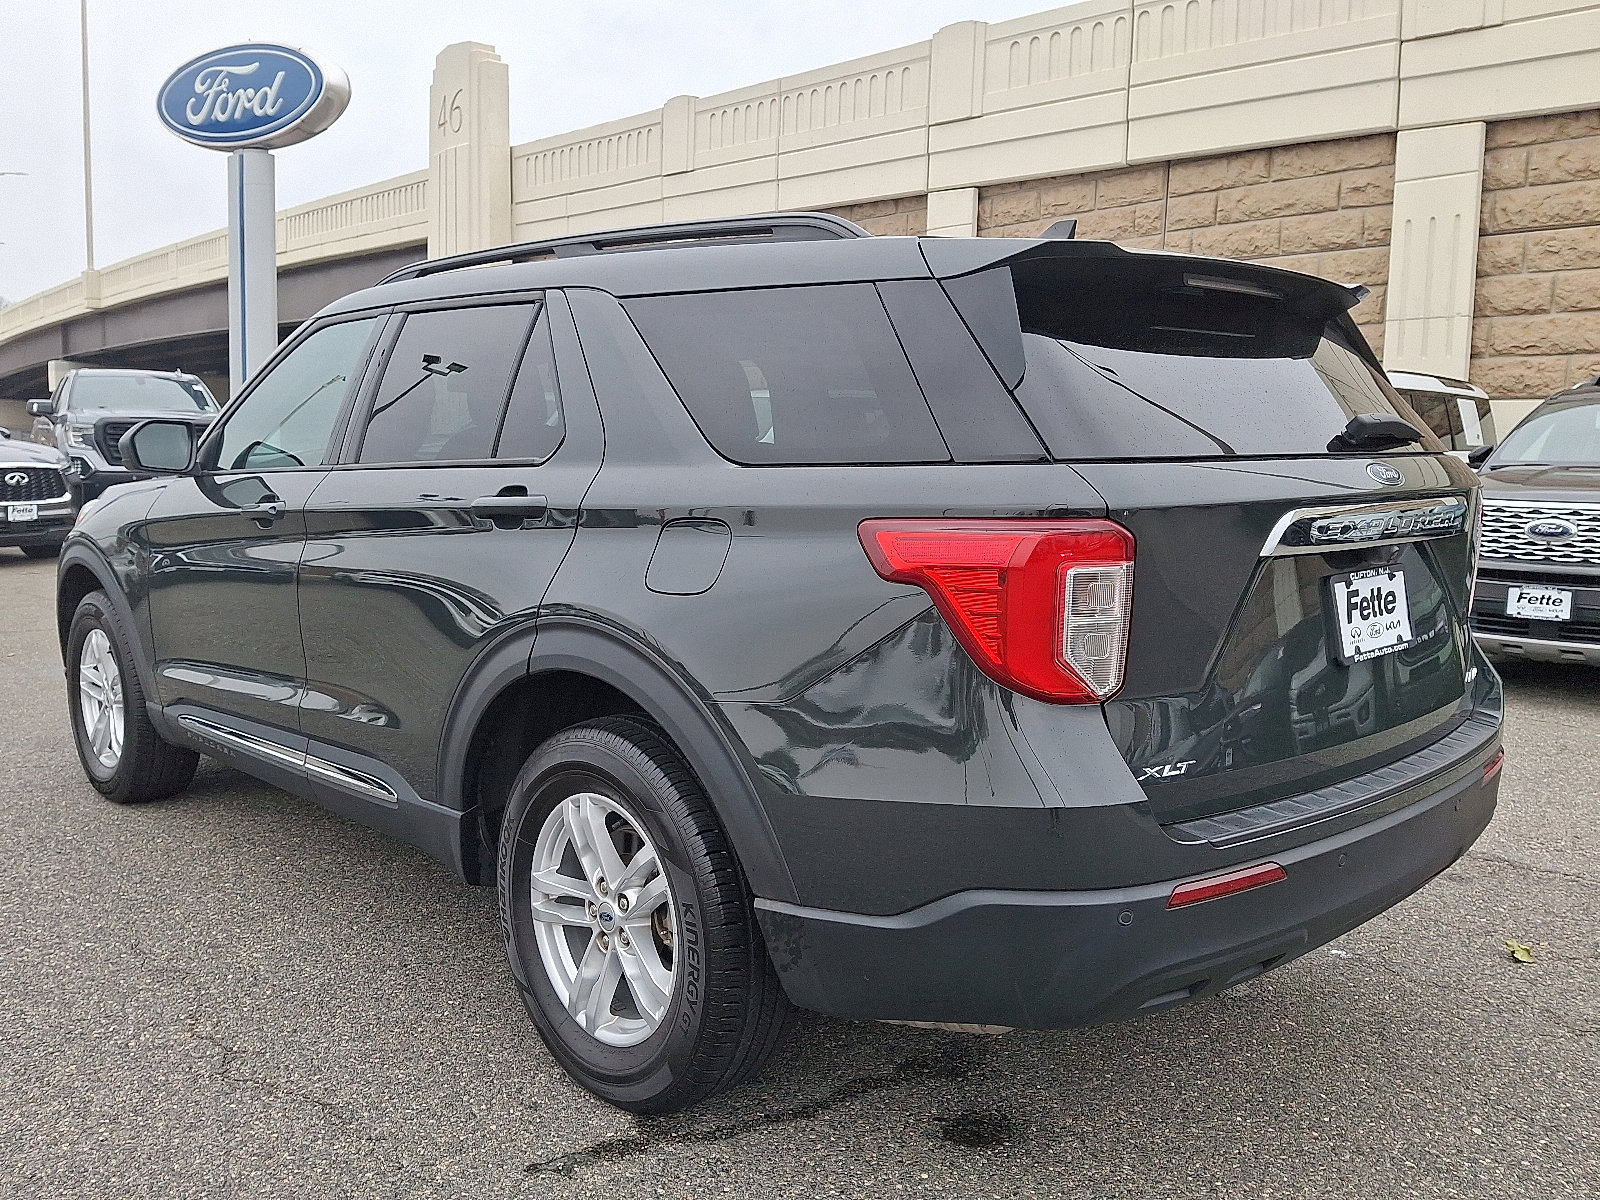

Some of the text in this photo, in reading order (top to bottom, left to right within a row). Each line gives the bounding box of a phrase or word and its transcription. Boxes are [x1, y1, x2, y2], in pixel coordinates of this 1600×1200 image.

[186, 61, 286, 126] Ford
[436, 88, 464, 137] 46
[1325, 513, 1461, 538] EXPLORER
[1535, 522, 1563, 534] Ford
[1346, 586, 1397, 625] Fette
[1516, 592, 1563, 607] Fette
[1353, 642, 1409, 662] FetteAuto.com
[1137, 760, 1197, 780] XLT
[681, 902, 701, 1016] KINERGY
